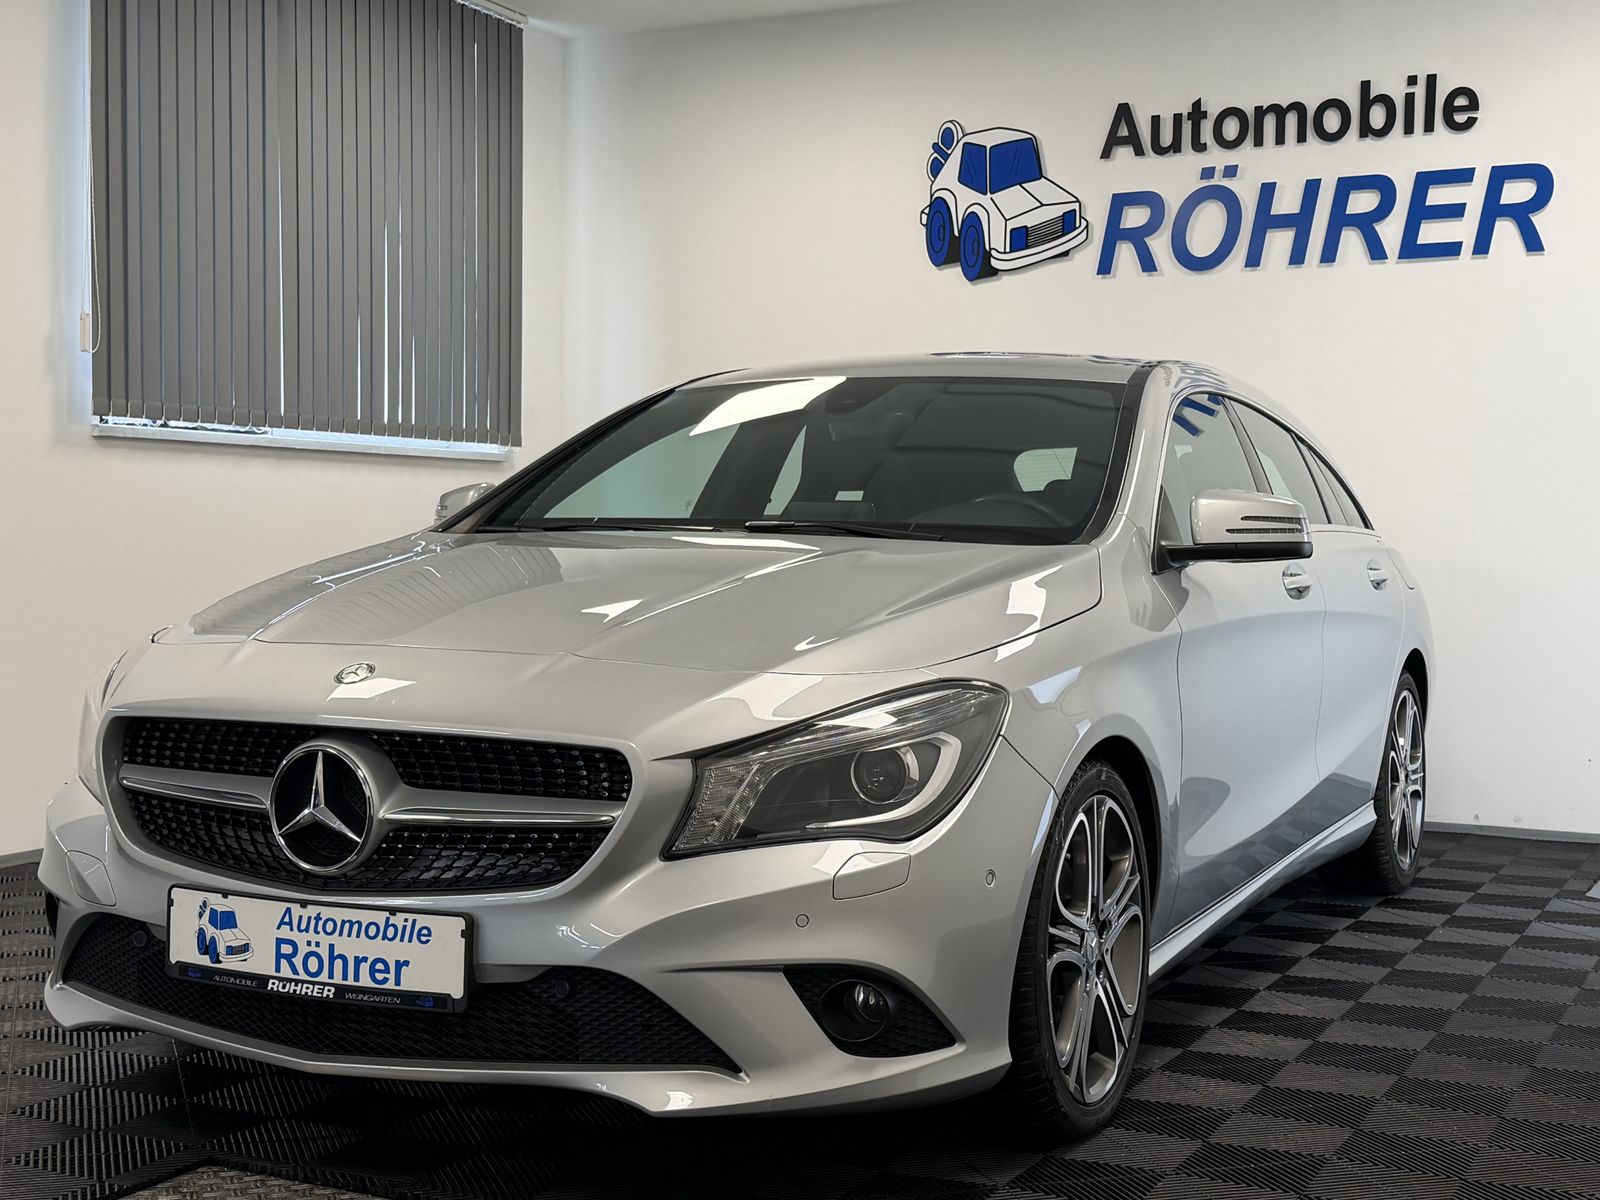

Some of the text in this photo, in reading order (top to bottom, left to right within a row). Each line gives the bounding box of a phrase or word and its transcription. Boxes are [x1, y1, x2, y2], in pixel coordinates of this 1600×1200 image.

[1100, 73, 1480, 160] Automobile
[1096, 163, 1554, 276] RÖHRER
[276, 906, 432, 944] Automobile
[274, 937, 411, 987] Röhrer
[345, 992, 401, 1004] WEINGARTEN
